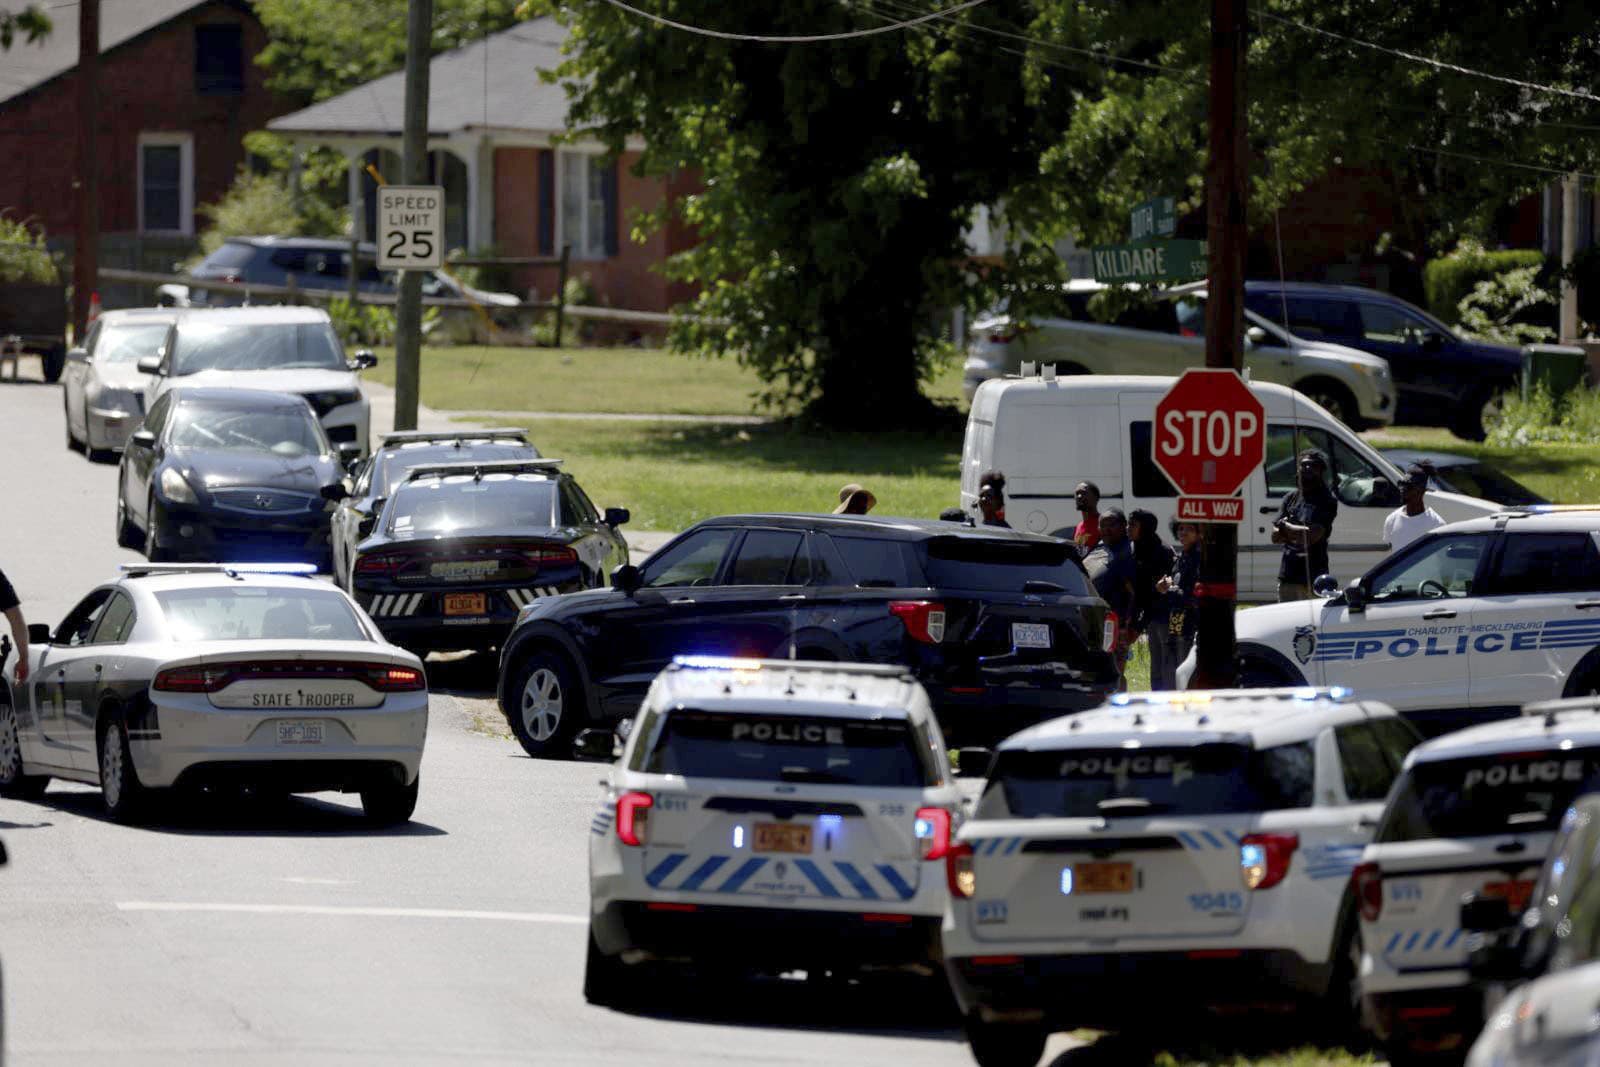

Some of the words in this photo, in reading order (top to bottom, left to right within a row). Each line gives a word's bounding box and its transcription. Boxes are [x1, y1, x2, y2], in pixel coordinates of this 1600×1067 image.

[384, 196, 437, 210] SPEED
[388, 213, 431, 226] LIMIT
[387, 230, 433, 259] 25
[1095, 247, 1167, 278] KILDARE
[1161, 409, 1258, 457] STOP
[1182, 501, 1207, 517] ALL
[1211, 501, 1240, 517] WAY
[1354, 630, 1541, 660] POLICE
[252, 693, 292, 707] STATE
[299, 692, 355, 707] TROOPER
[732, 722, 845, 745] POLICE
[1060, 754, 1175, 776] POLICE
[1464, 759, 1585, 789] POLICE
[1188, 891, 1243, 911] 1045
